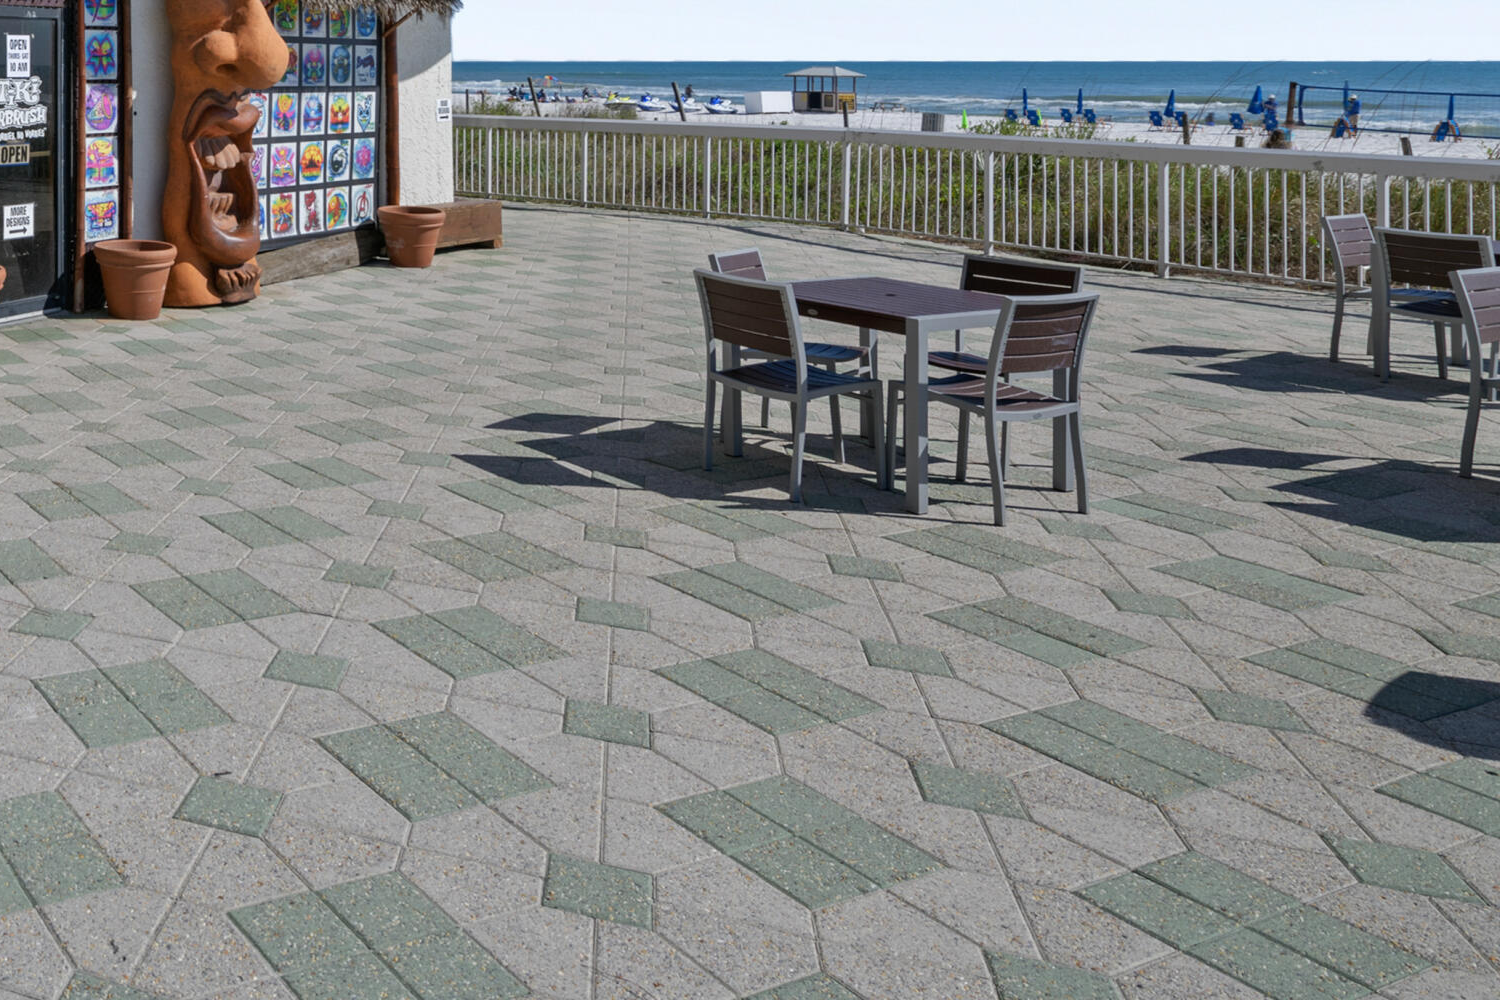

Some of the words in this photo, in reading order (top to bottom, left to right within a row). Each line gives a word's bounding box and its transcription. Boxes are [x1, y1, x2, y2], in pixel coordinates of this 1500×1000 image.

[9, 39, 28, 51] OPEN
[10, 62, 17, 72] 10
[17, 62, 29, 72] AM
[1, 146, 28, 164] OPEN
[10, 206, 27, 217] MORE
[6, 216, 30, 228] DESIGNS
